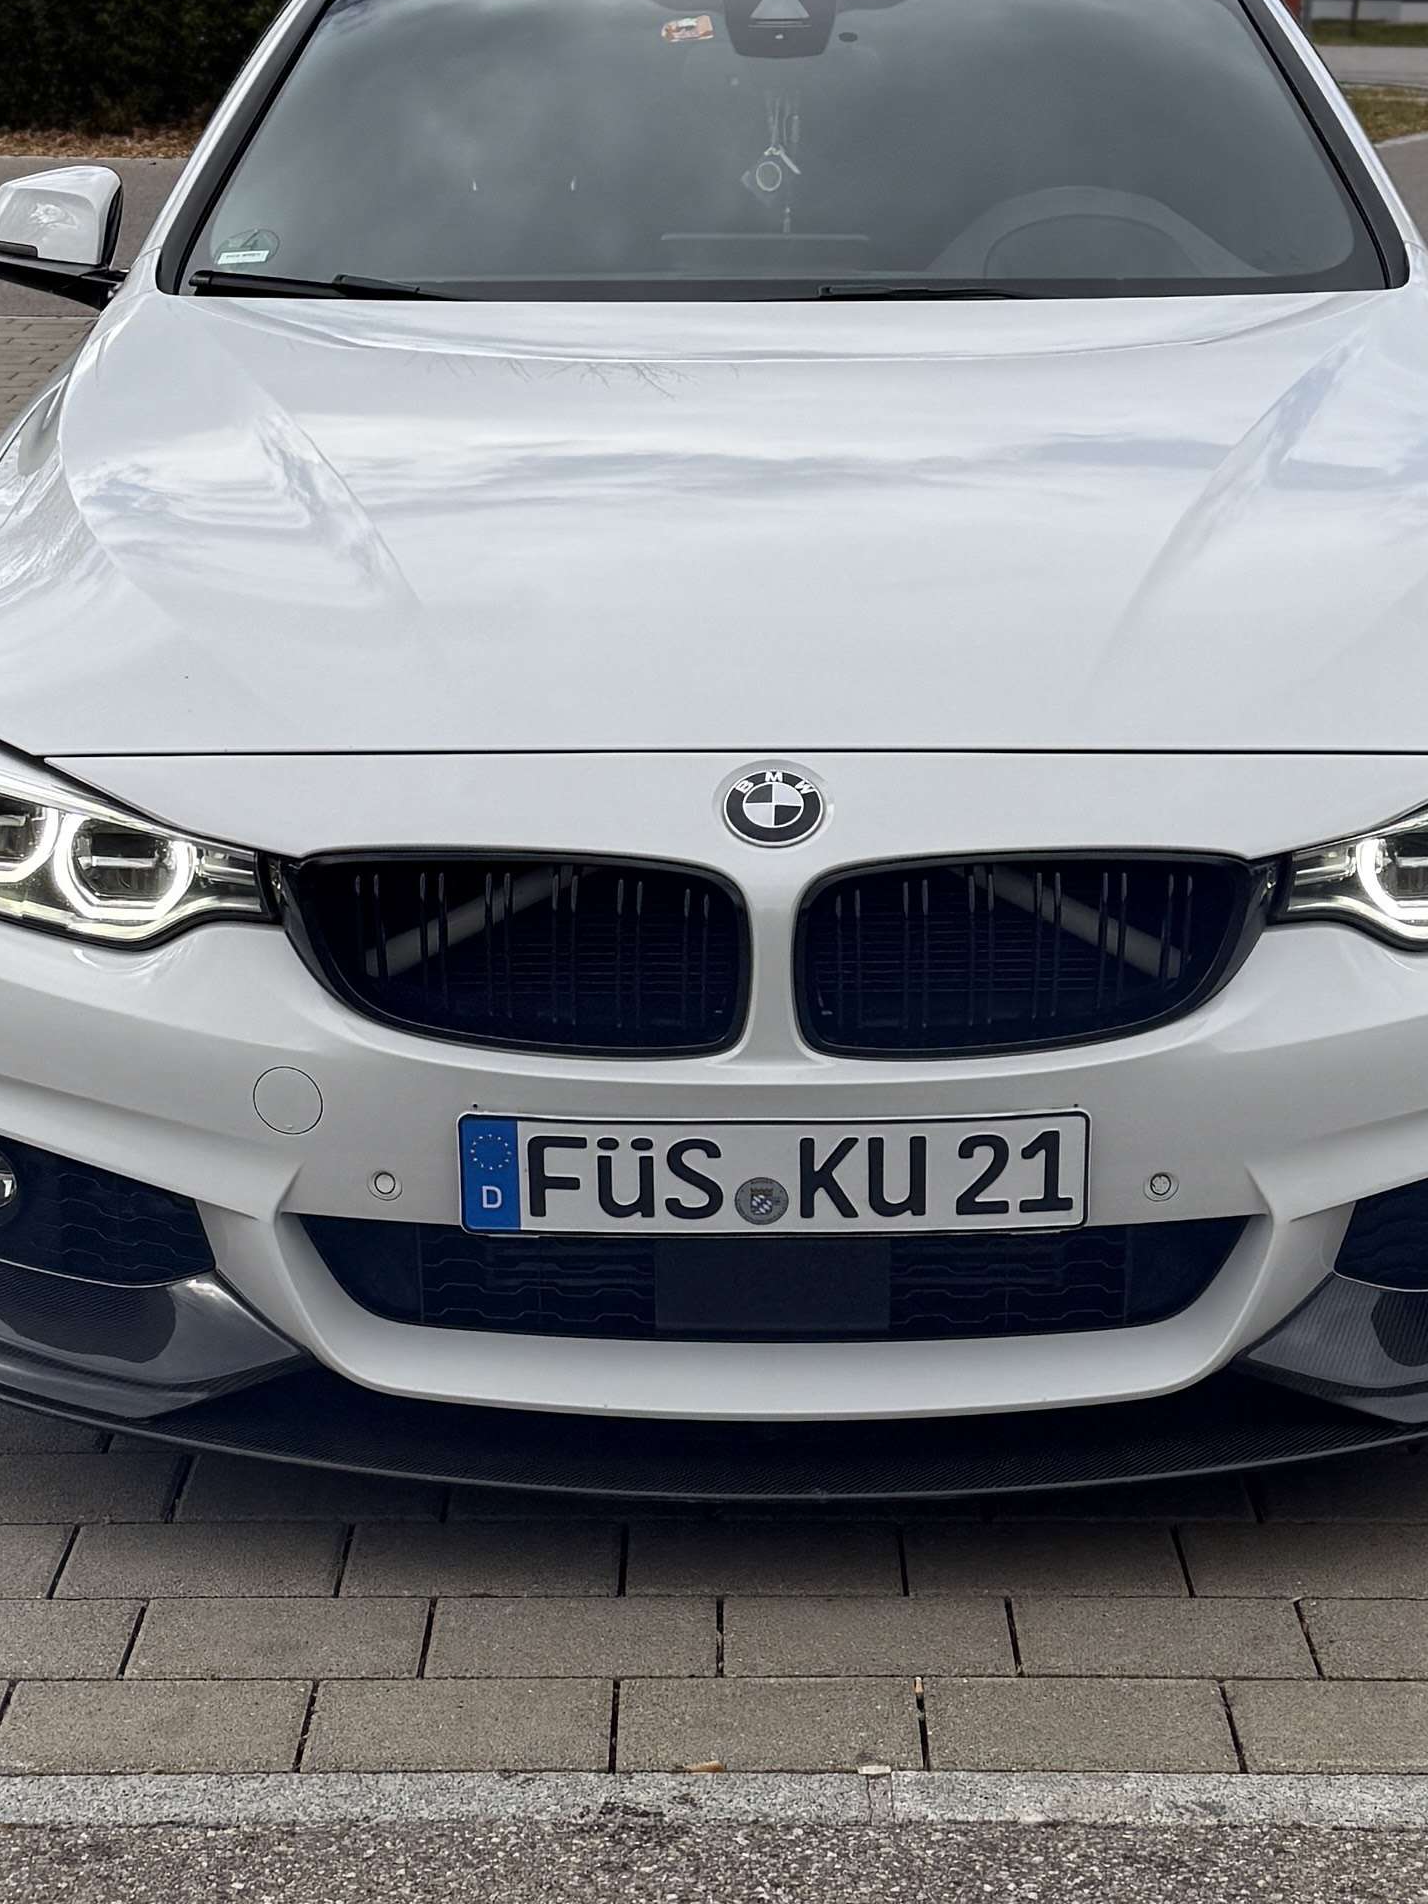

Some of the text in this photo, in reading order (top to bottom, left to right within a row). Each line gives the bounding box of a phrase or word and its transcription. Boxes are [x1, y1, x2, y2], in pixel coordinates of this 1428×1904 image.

[735, 770, 815, 795] BMW
[799, 1135, 927, 1219] KU
[955, 1130, 1075, 1216] 21
[481, 1186, 503, 1210] D
